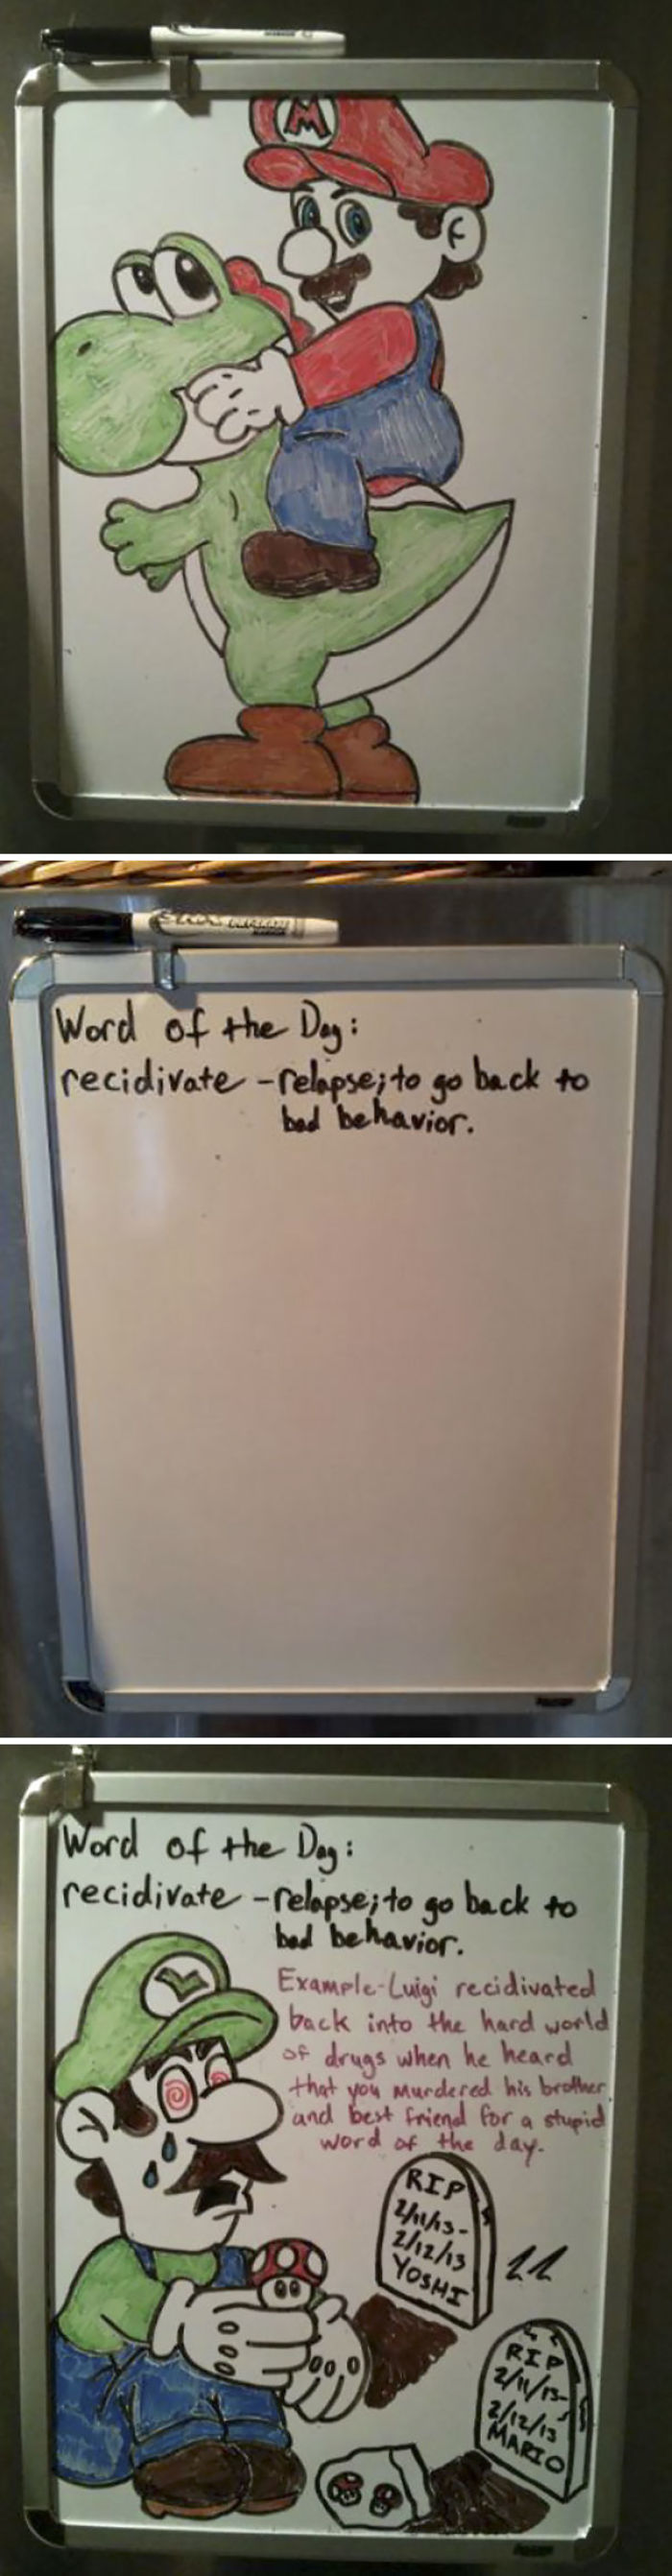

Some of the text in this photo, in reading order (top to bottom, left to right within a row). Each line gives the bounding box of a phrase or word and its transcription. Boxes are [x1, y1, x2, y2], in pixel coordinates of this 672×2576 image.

[283, 99, 329, 137] M
[56, 999, 359, 1054] Word of the Day:
[61, 1058, 247, 1097] recidivate
[432, 1067, 462, 1107] go
[474, 1056, 540, 1091] back
[556, 1065, 589, 1093] to
[282, 1097, 474, 1136] bad behavior.
[60, 1818, 352, 1873] Word of the Day:
[62, 1872, 243, 1910] recidivate
[424, 1893, 452, 1926] go
[466, 1879, 529, 1917] back
[544, 1892, 576, 1918] to
[276, 1918, 463, 1957] bad behavior.
[456, 1968, 595, 1998] recidivated
[289, 2004, 610, 2034] back into the hard world
[282, 2040, 571, 2079] of drugs when he heard
[289, 2075, 337, 2096] that
[348, 2082, 379, 2103] you
[505, 2076, 531, 2097] his
[540, 2071, 606, 2094] brother
[293, 2101, 606, 2134] and best friend for a stupid
[321, 2127, 543, 2167] word of the day.
[405, 2168, 466, 2201] RIP
[392, 2230, 467, 2271] 2/12/13
[393, 2254, 469, 2306] YOSHI
[505, 2342, 564, 2371] RIP
[487, 2399, 557, 2443] 2/12/13
[487, 2421, 565, 2473] MARIO
